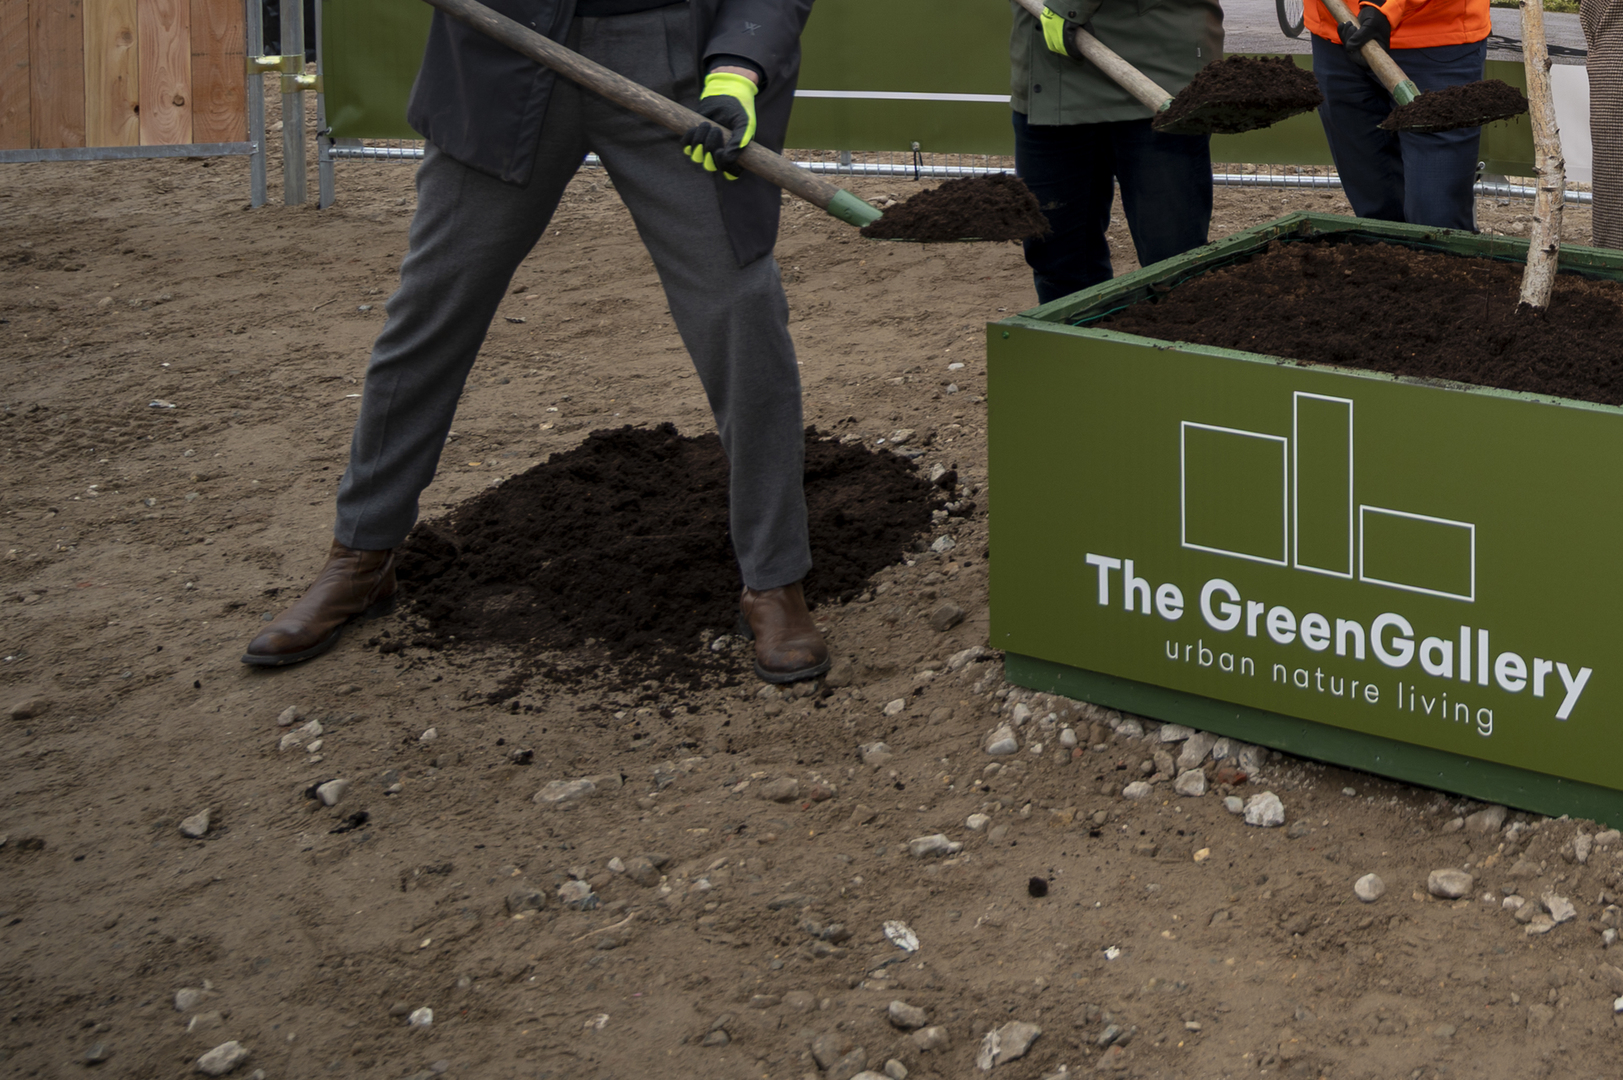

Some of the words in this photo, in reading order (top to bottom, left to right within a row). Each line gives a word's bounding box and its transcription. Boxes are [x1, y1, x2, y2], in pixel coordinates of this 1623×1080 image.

[1085, 552, 1185, 621] The
[1199, 577, 1593, 720] GreenGallery
[1165, 639, 1256, 677] urban
[1272, 661, 1381, 704] nature
[1398, 681, 1496, 737] living
